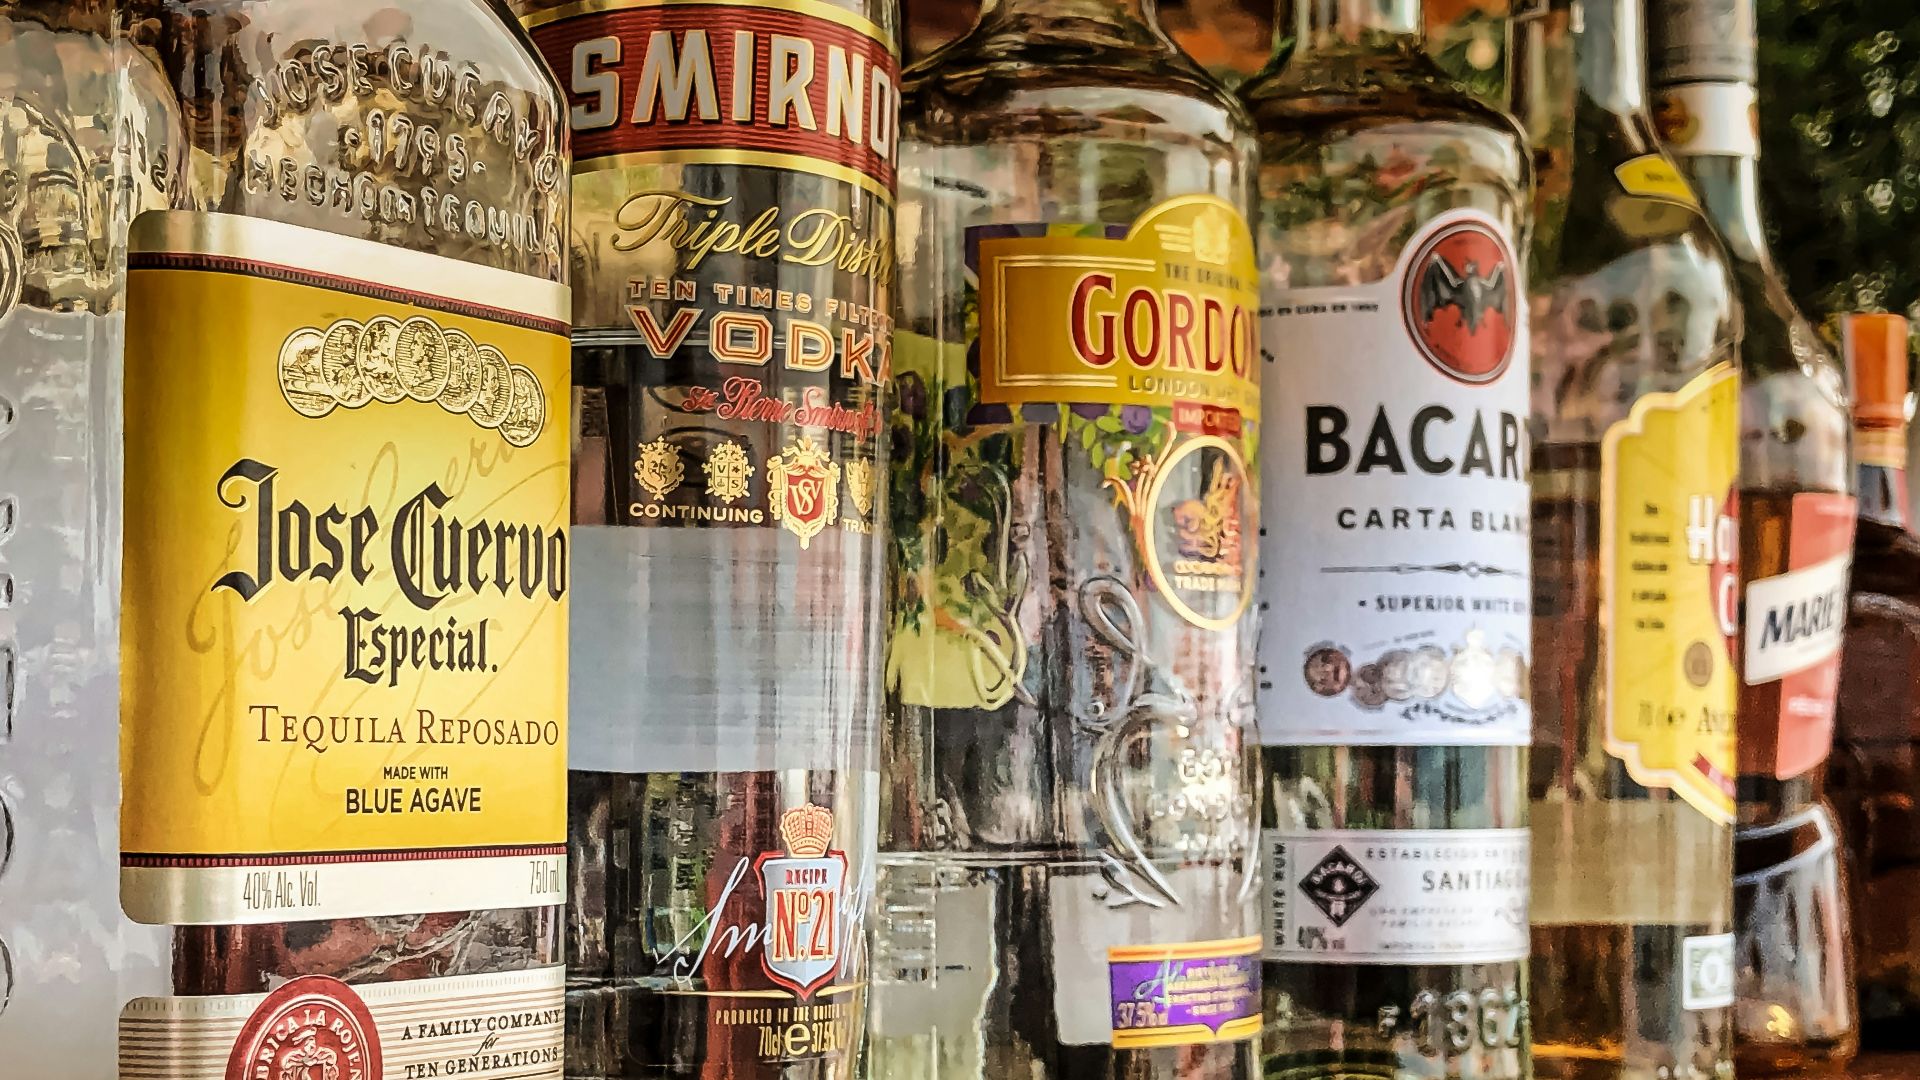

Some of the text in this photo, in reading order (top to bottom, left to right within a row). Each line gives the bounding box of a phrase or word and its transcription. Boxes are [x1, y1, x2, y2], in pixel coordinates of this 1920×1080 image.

[571, 28, 900, 165] SMIRNO
[612, 190, 781, 271] Triple
[628, 279, 697, 302] TEN
[713, 282, 813, 313] TIMES
[629, 502, 764, 524] CONTINUING
[1337, 506, 1456, 531] CARTA
[211, 457, 381, 602] Jose
[391, 481, 567, 611] Cuervo
[1375, 594, 1465, 613] SUPERIOR
[338, 606, 499, 688] Especial.
[249, 705, 560, 753] TEQUILA REPOSADO
[383, 765, 449, 781] MADE WITH
[345, 786, 482, 815] BLUE AGAVE
[242, 869, 322, 911] 40% Alc. Vol.
[529, 860, 549, 896] 750
[304, 1009, 326, 1027] LA
[400, 1008, 561, 1041] A FAMILY COMPANY
[715, 1008, 773, 1025] PRODUCED
[778, 1007, 789, 1023] IN
[793, 1005, 810, 1022] THE
[471, 1031, 500, 1057] for
[758, 1025, 782, 1057] 70cl
[404, 1046, 559, 1080] TEN GENERATIONS
